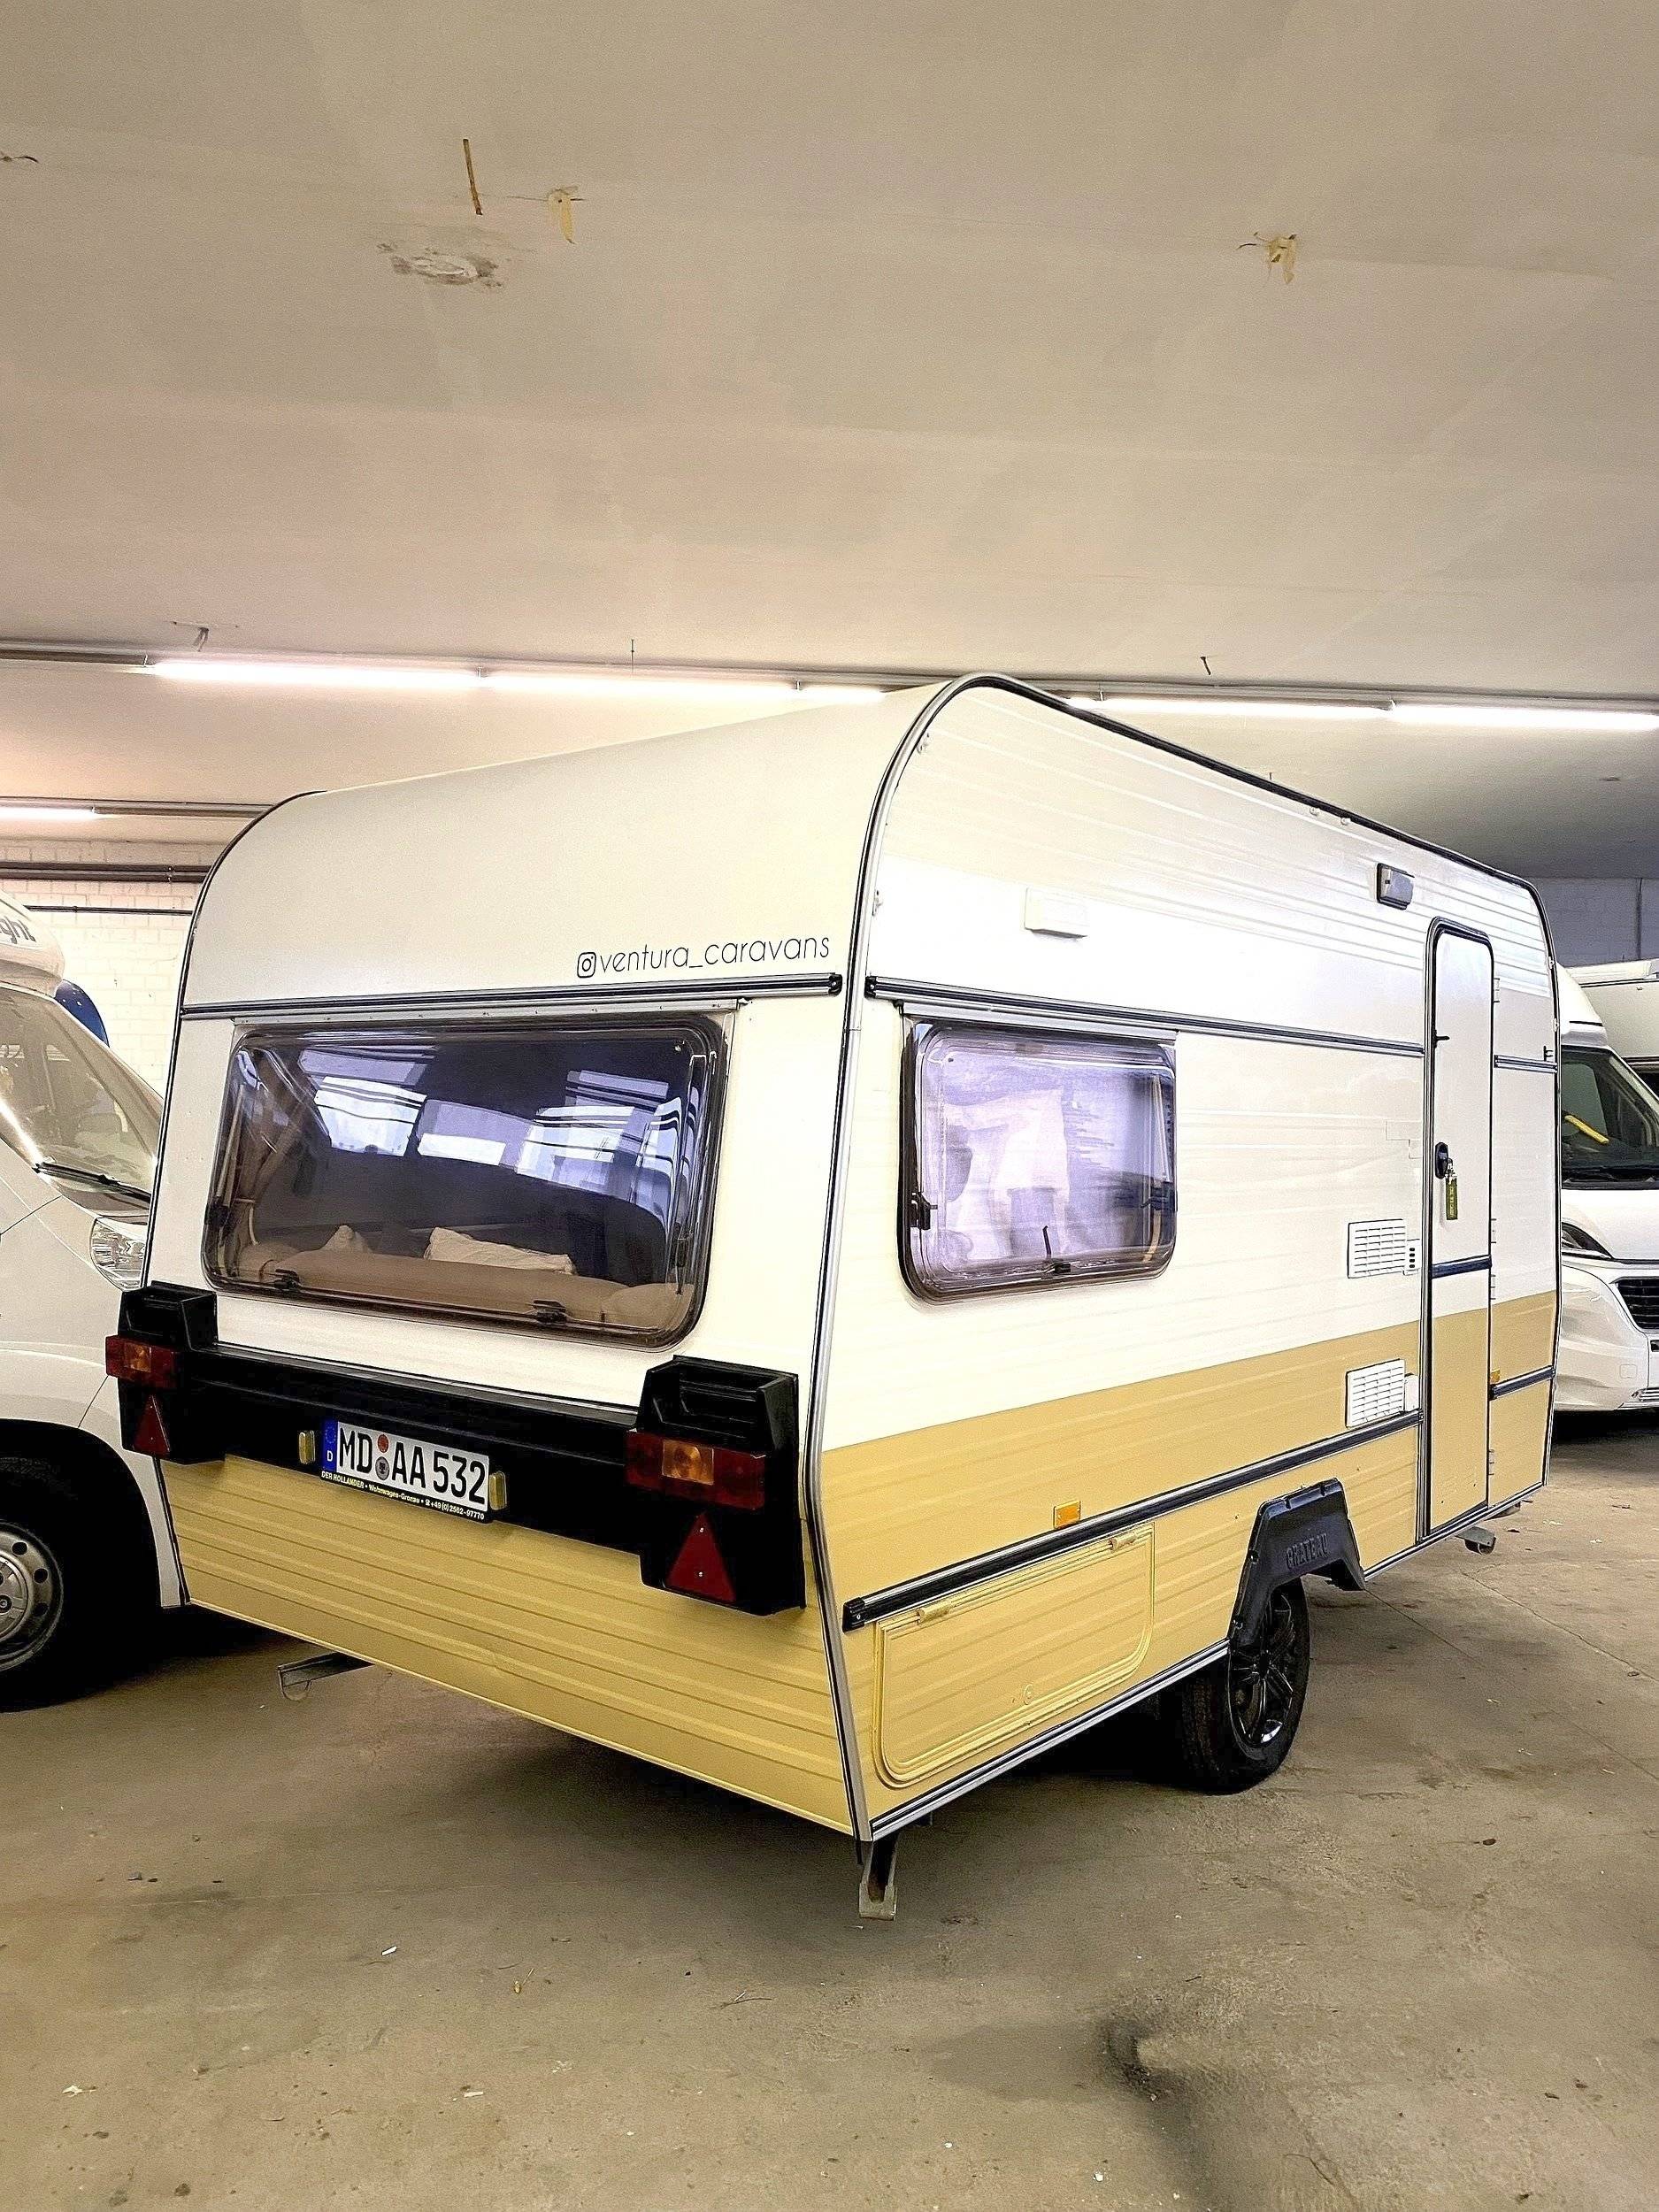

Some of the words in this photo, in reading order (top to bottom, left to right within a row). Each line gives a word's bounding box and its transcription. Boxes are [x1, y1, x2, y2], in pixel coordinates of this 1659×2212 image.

[600, 936, 830, 973] ventura_caravans
[326, 1450, 334, 1462] D
[339, 1427, 373, 1473] MD
[391, 1441, 426, 1489] AA
[433, 1450, 486, 1505] 532
